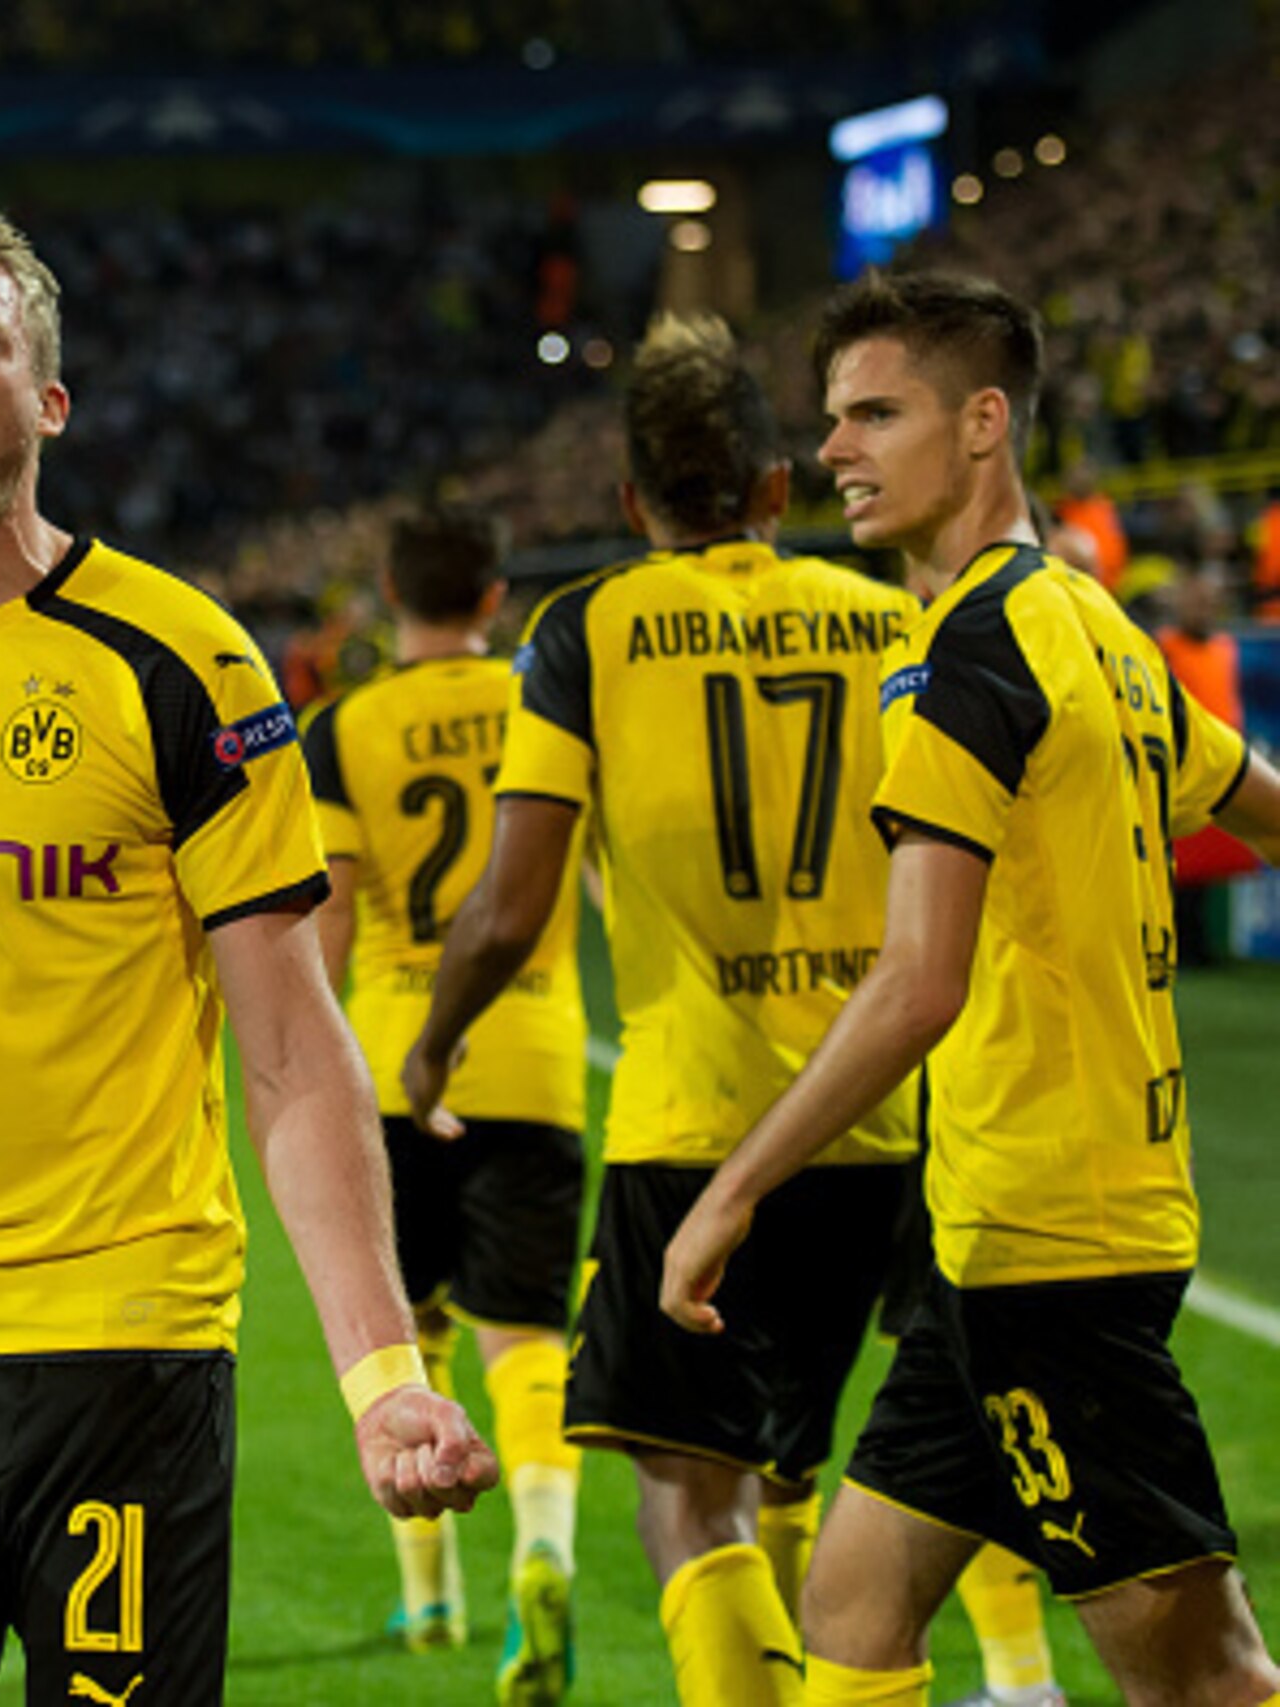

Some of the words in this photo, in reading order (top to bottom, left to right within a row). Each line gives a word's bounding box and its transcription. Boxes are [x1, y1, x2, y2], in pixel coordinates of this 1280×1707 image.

[10, 710, 74, 760] BVB
[704, 671, 848, 903] 17
[400, 764, 499, 945] 2
[983, 1387, 1073, 1508] 33
[64, 1500, 145, 1652] 21
